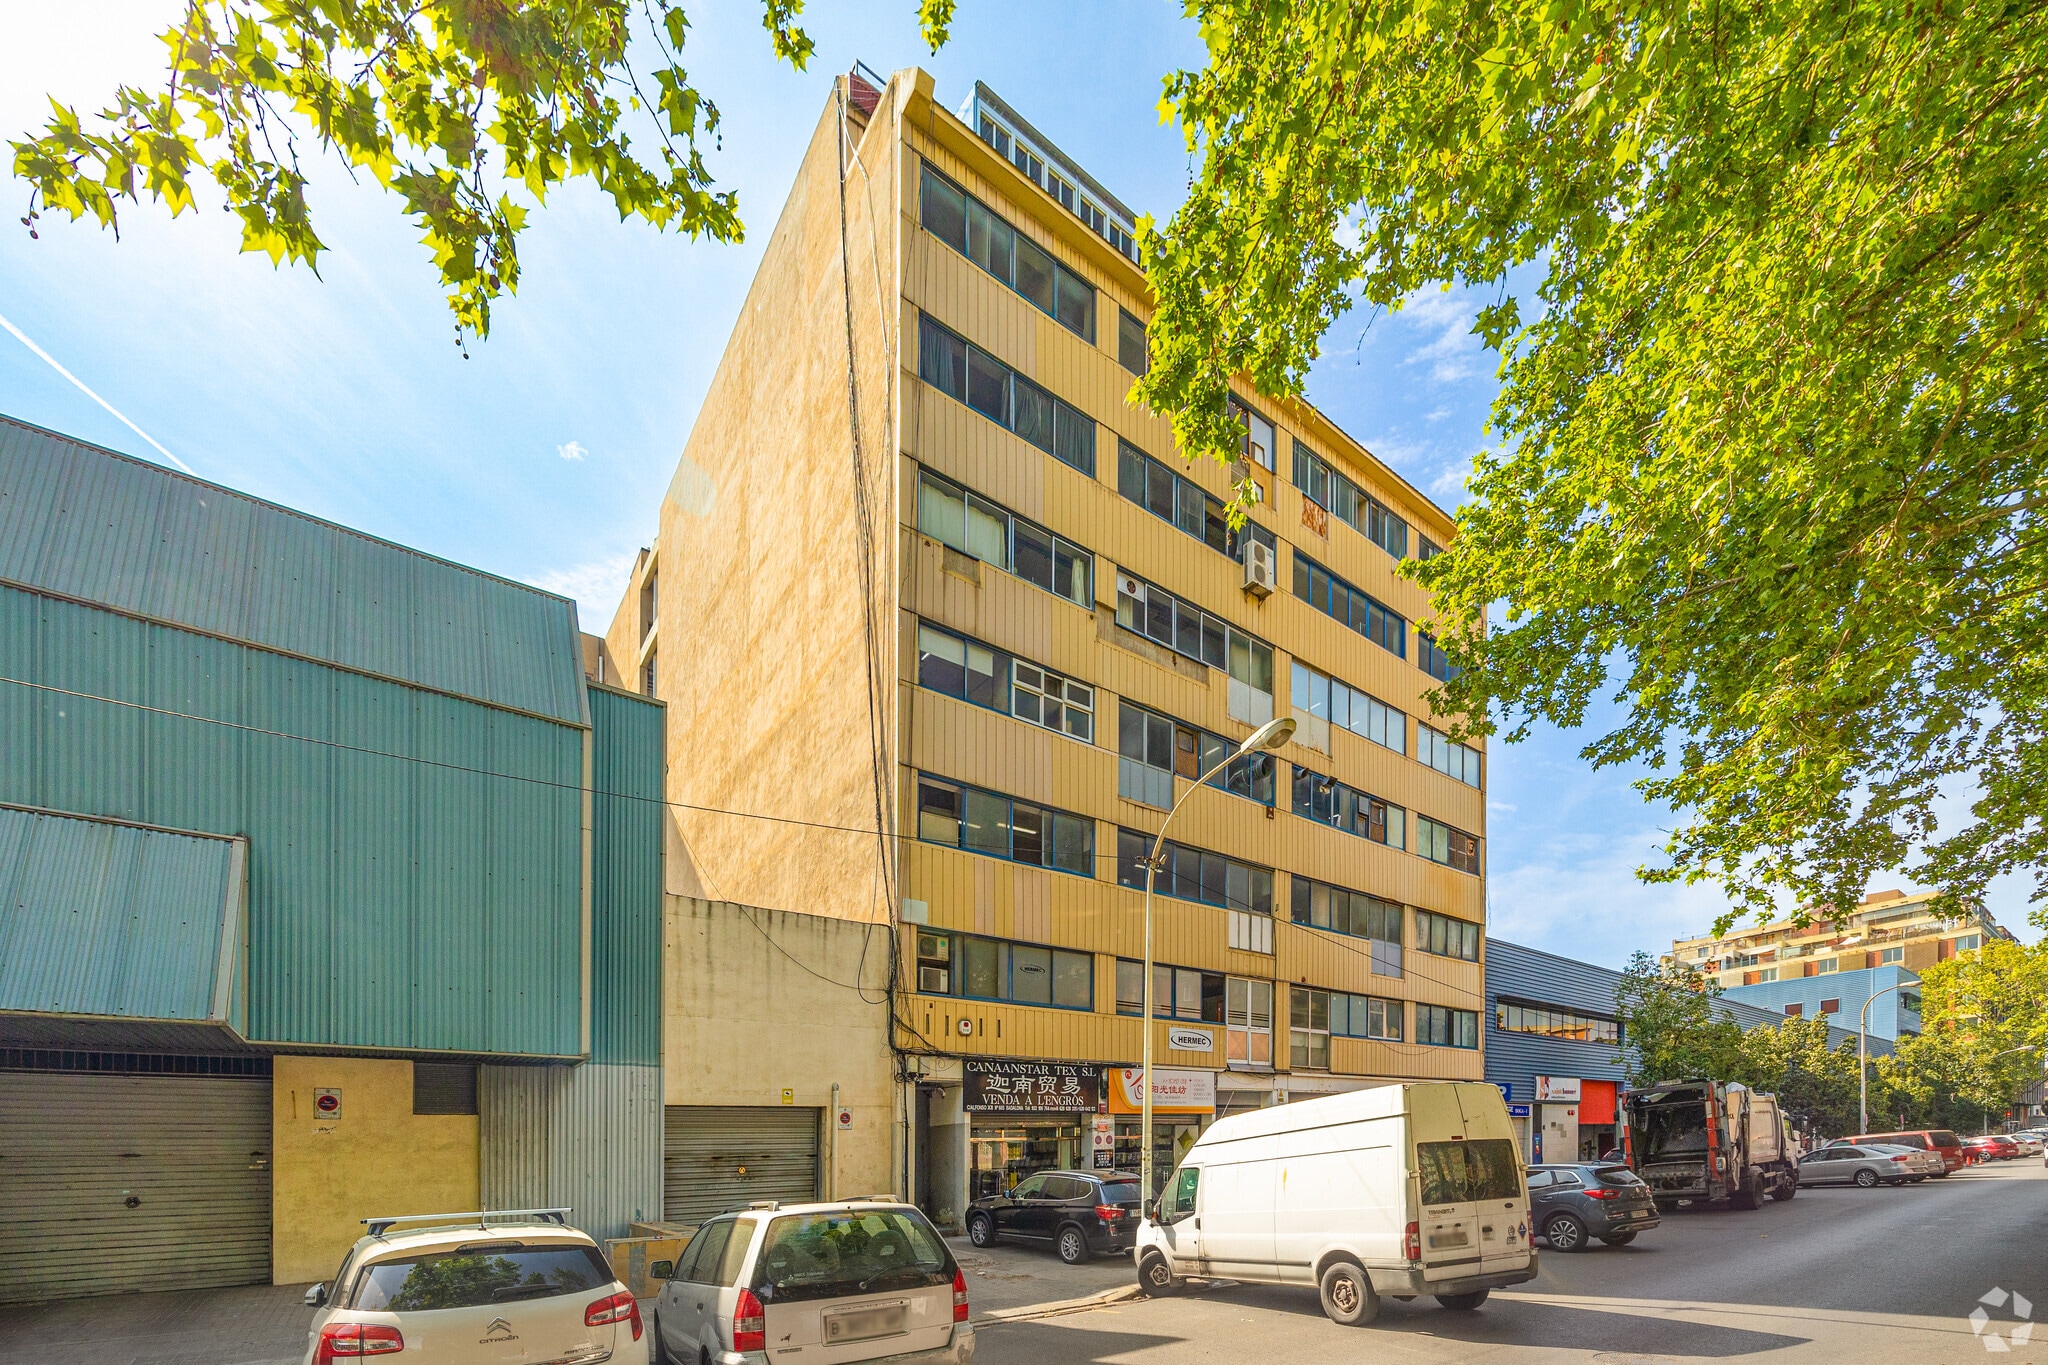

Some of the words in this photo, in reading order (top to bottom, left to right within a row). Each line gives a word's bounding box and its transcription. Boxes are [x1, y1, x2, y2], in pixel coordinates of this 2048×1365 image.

[1178, 1036, 1206, 1045] HERMEC
[966, 1062, 1049, 1075] CANAANSTAR
[1054, 1066, 1077, 1076] TEX
[985, 1074, 1081, 1095] 迦南贸易
[982, 1094, 1020, 1105] VENDA
[1024, 1095, 1033, 1105] A
[1037, 1094, 1084, 1106] L'ENGRÒS
